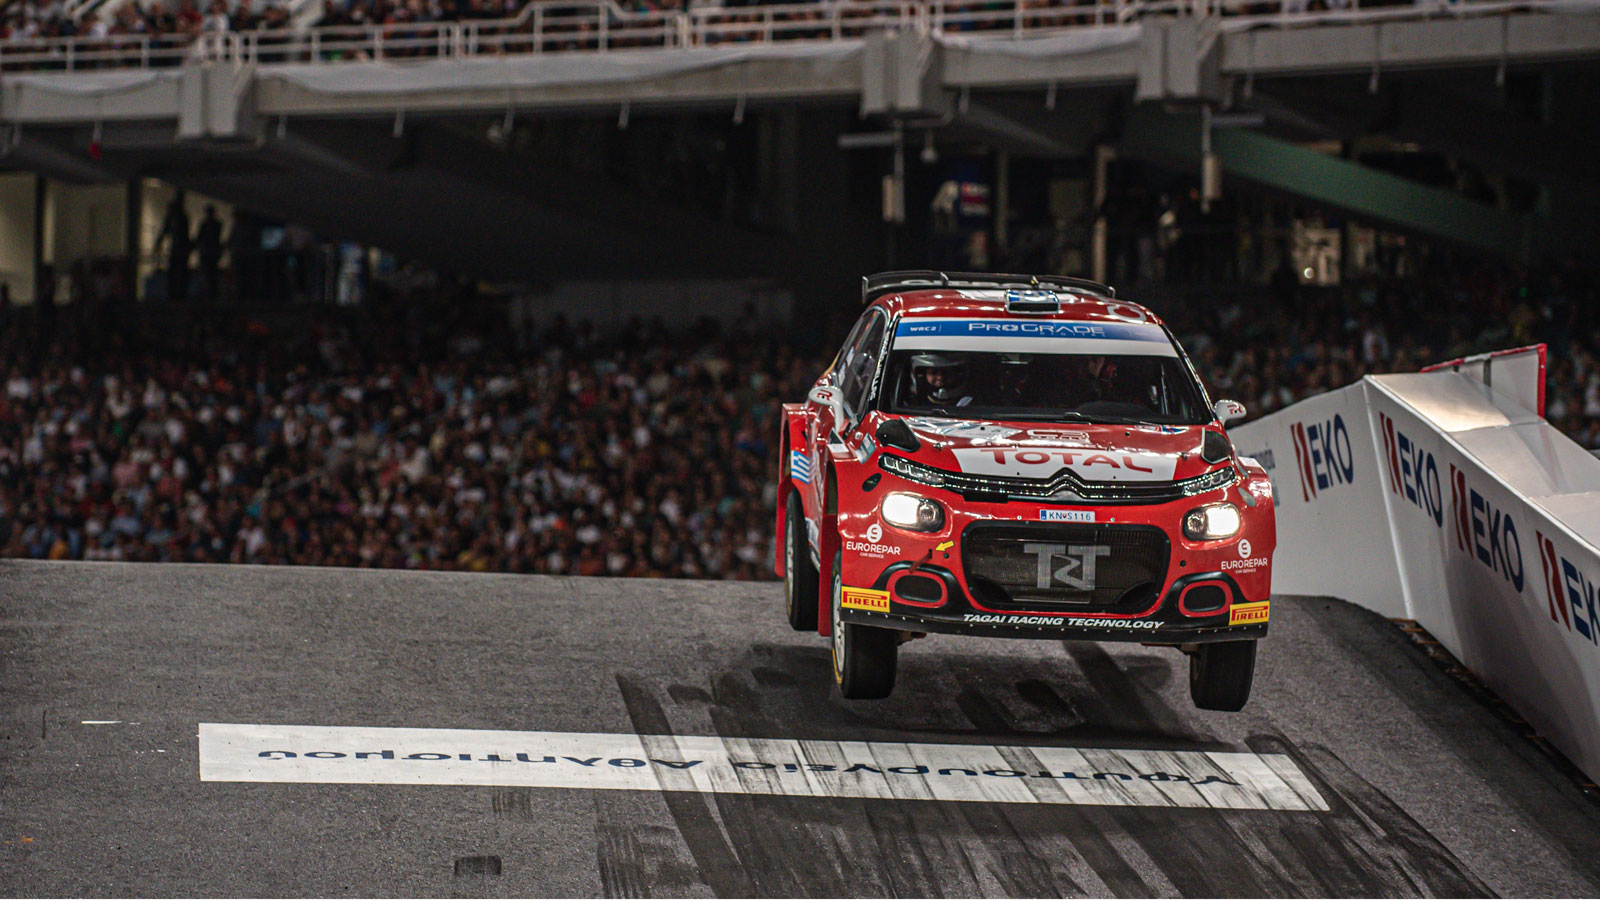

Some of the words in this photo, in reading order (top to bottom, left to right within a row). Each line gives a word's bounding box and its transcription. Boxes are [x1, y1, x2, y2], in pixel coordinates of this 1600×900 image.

[979, 448, 1154, 474] TOTAL
[1306, 413, 1355, 490] EKO
[1398, 431, 1443, 528] EKO
[845, 541, 901, 556] EUROREPAR
[1470, 488, 1524, 593] EKO
[1220, 557, 1268, 571] EUROREPAR
[842, 590, 888, 609] PIRELLI
[1561, 556, 1600, 646] EK
[963, 613, 1007, 624] TAGAI
[1007, 615, 1064, 626] RACING
[1068, 617, 1165, 629] TECHNOLOGY
[1231, 605, 1269, 622] PIRELLI
[257, 749, 705, 769] Αθλητισμού
